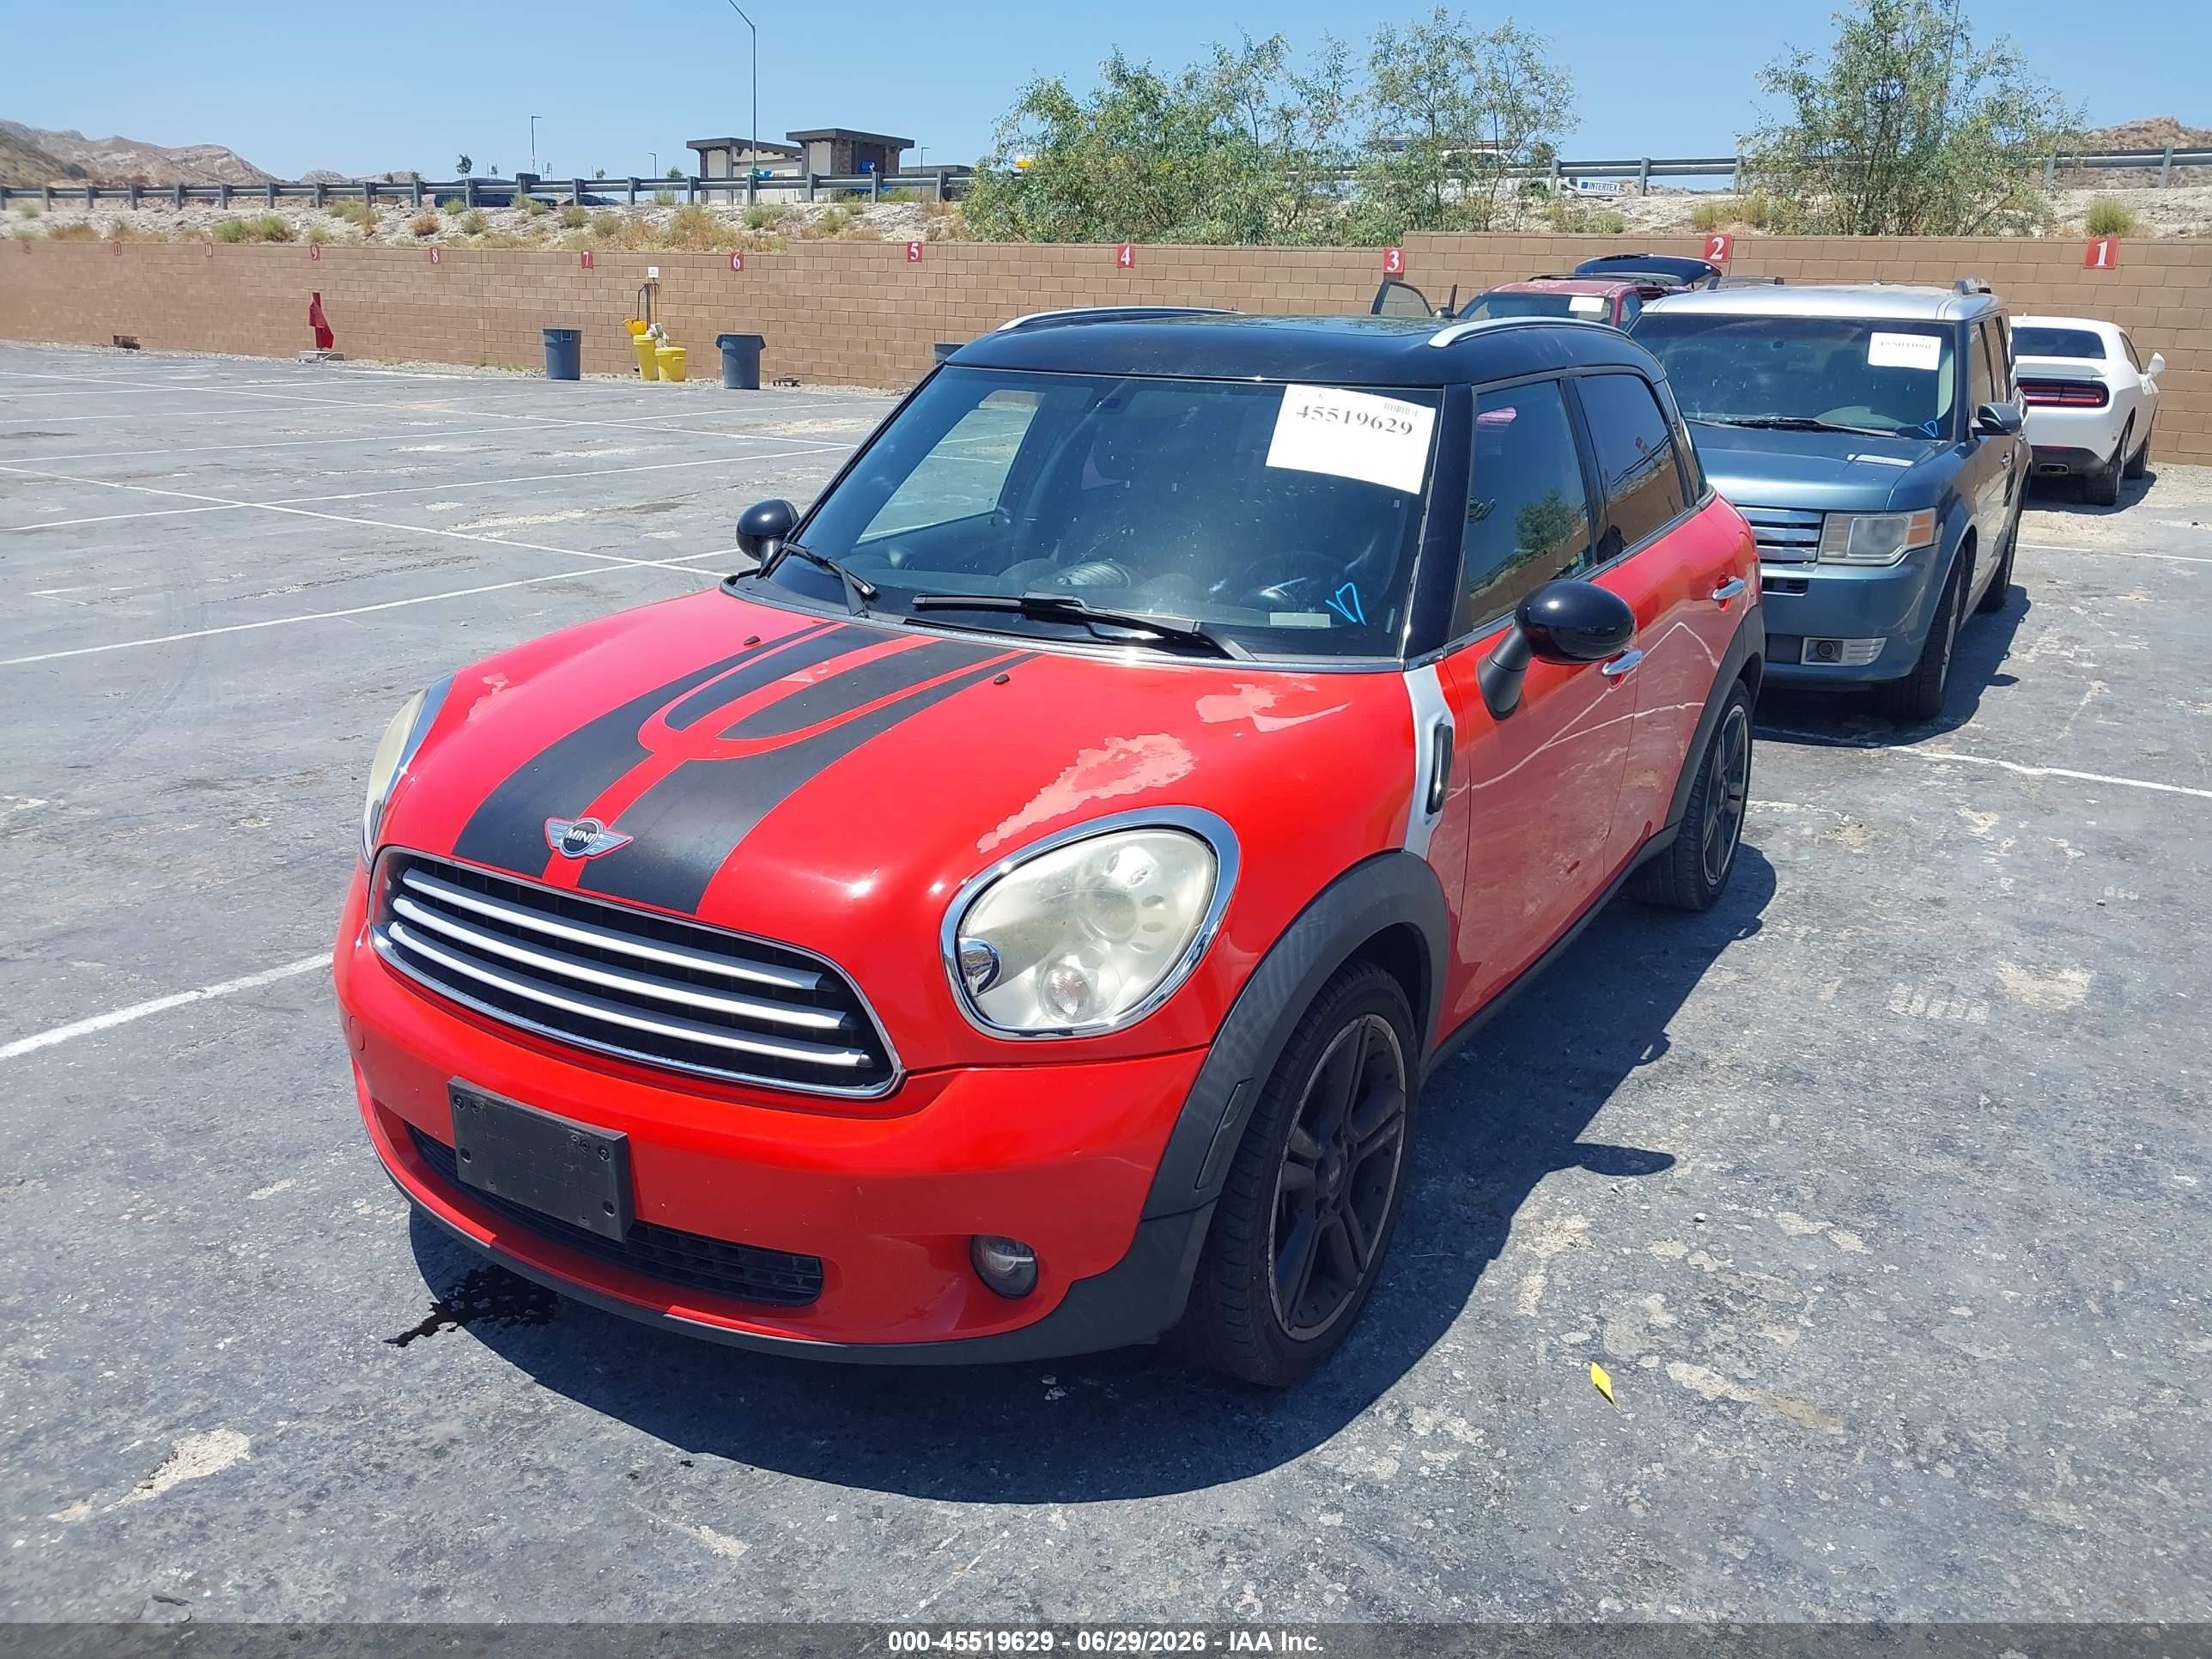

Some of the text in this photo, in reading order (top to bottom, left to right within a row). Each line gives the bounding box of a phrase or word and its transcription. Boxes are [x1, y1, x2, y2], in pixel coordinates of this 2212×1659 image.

[1589, 182, 1618, 192] INTERTEX
[312, 246, 318, 260] 9
[432, 248, 439, 263] 8
[910, 242, 919, 260] 5
[1120, 245, 1130, 265] 4
[1709, 236, 1724, 260] 2
[2094, 240, 2108, 266] 1
[583, 252, 590, 266] 7
[732, 253, 741, 270] 6
[1386, 250, 1400, 271] 3
[1296, 404, 1413, 436] 45519629
[566, 829, 596, 843] MINI
